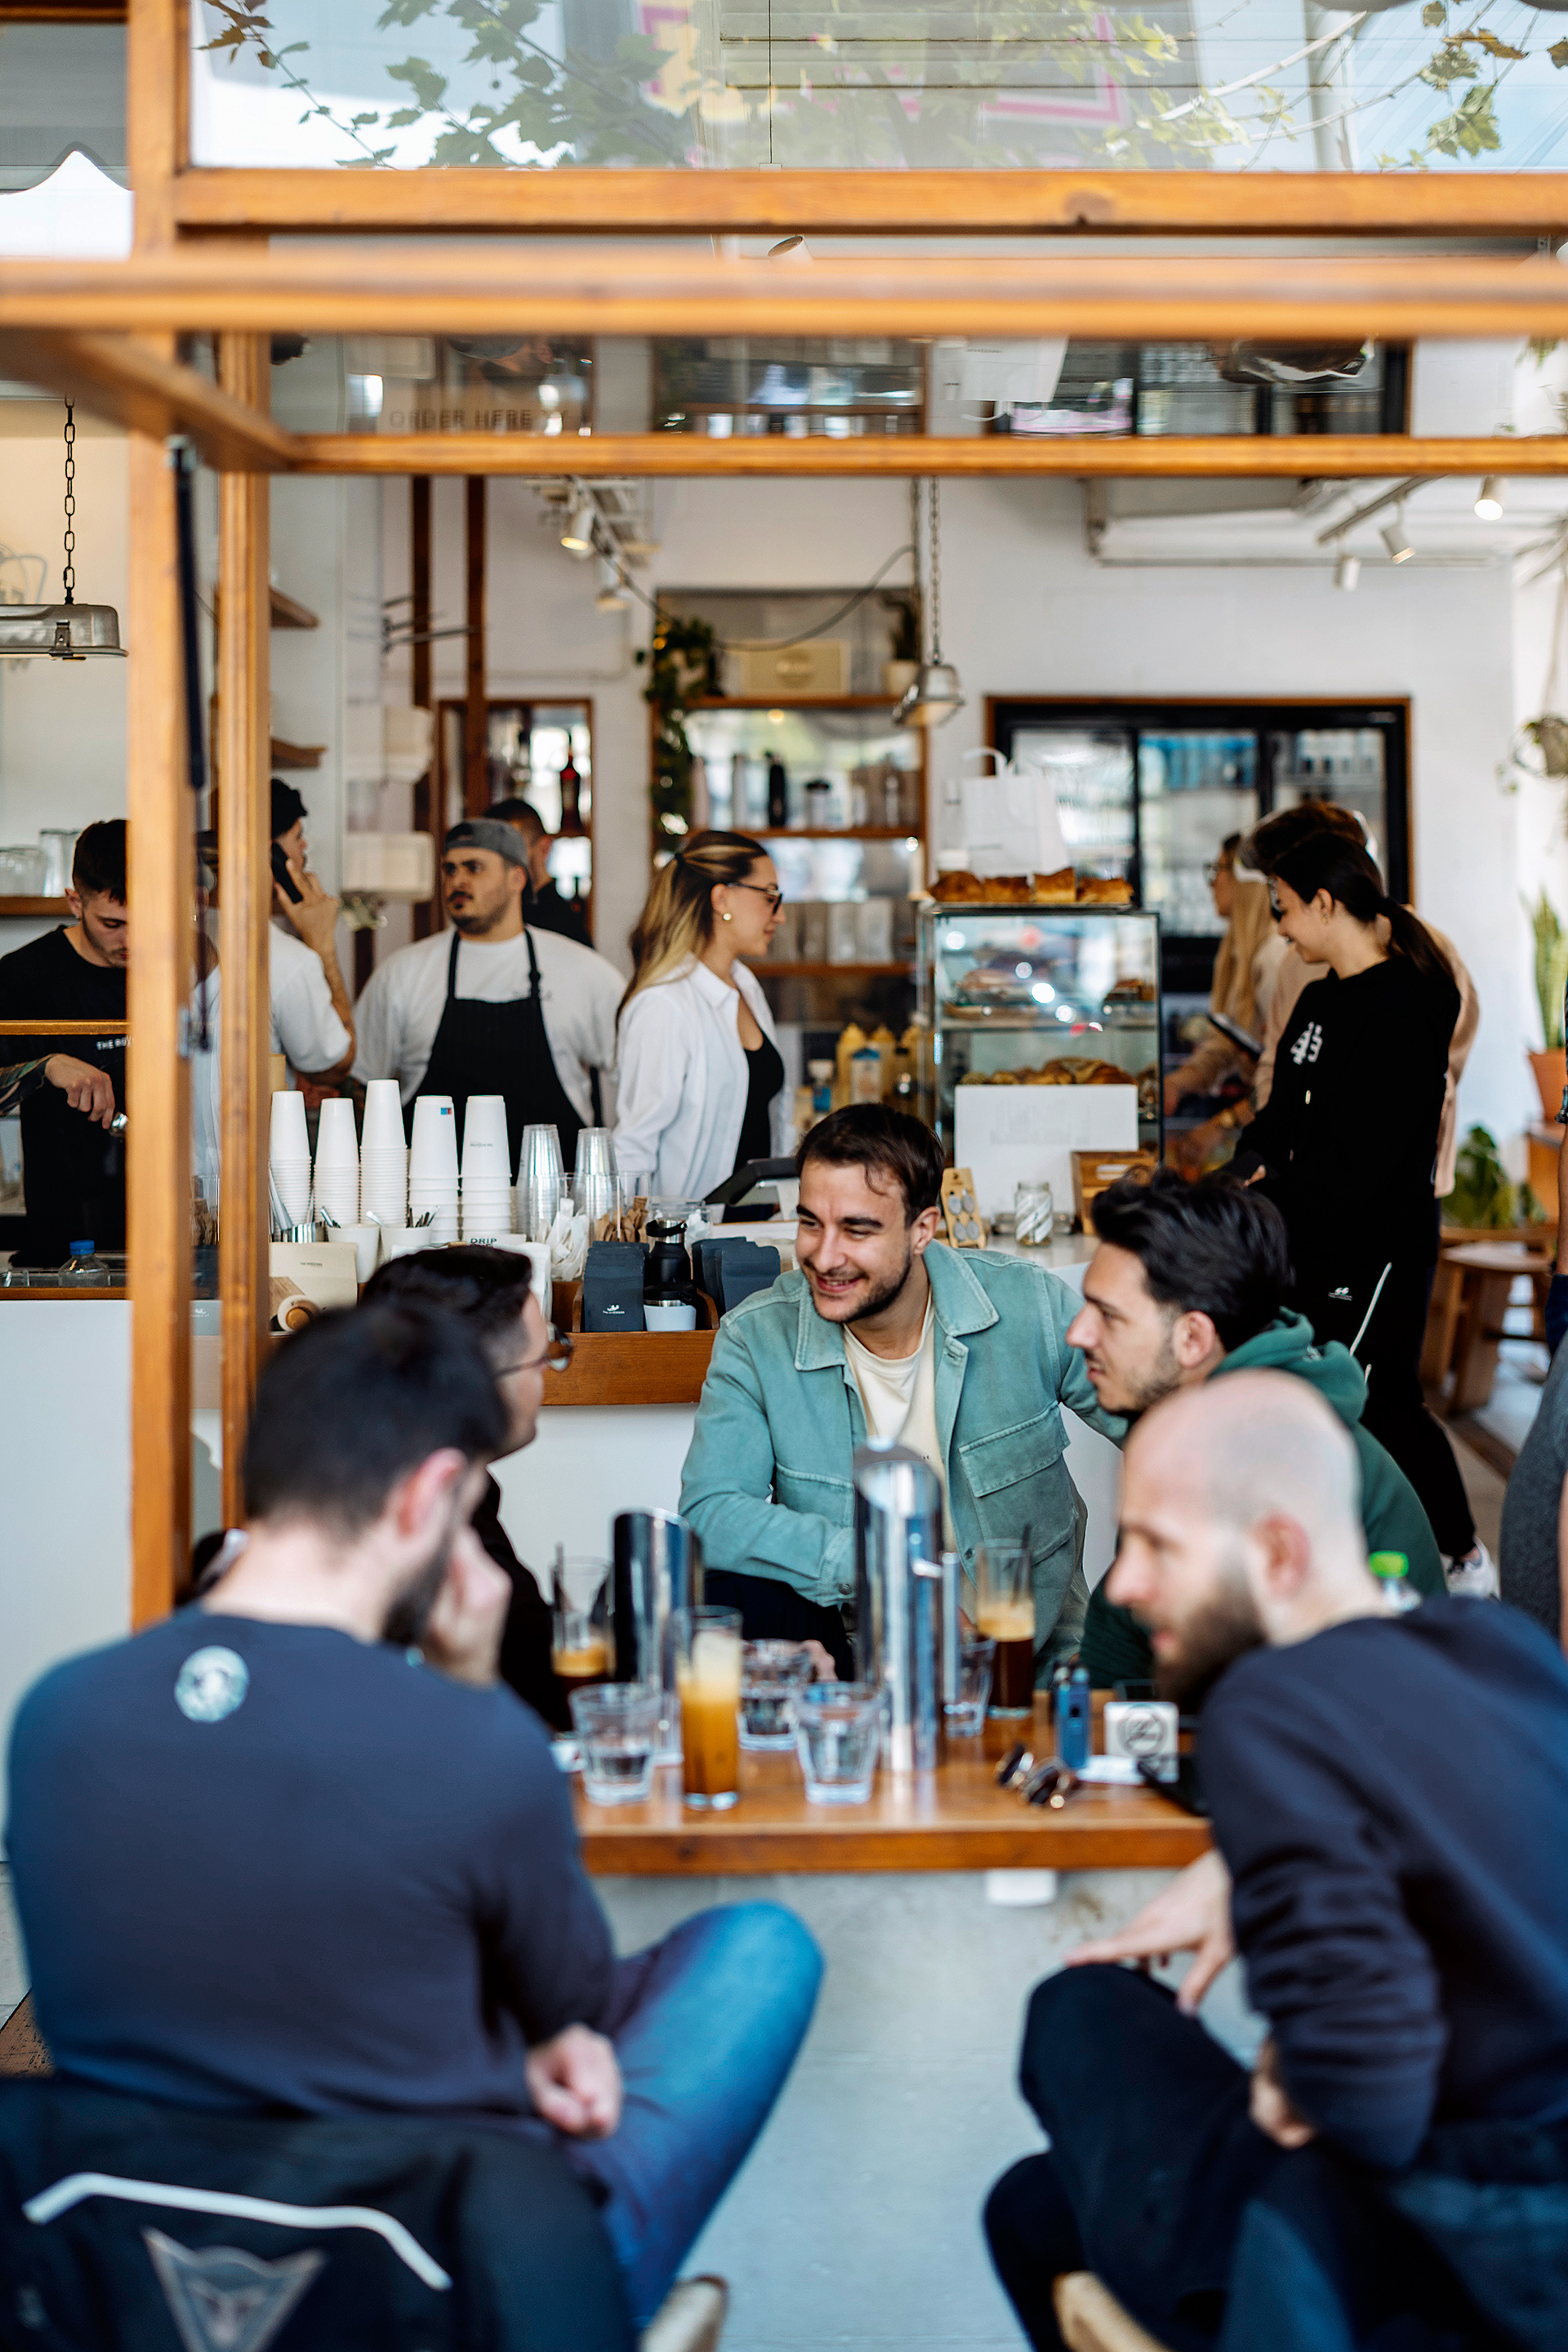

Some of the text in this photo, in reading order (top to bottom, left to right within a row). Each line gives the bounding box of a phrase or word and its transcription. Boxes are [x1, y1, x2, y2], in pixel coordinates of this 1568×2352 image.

[390, 409, 531, 428] ORDER HERE
[97, 1040, 114, 1050] THE
